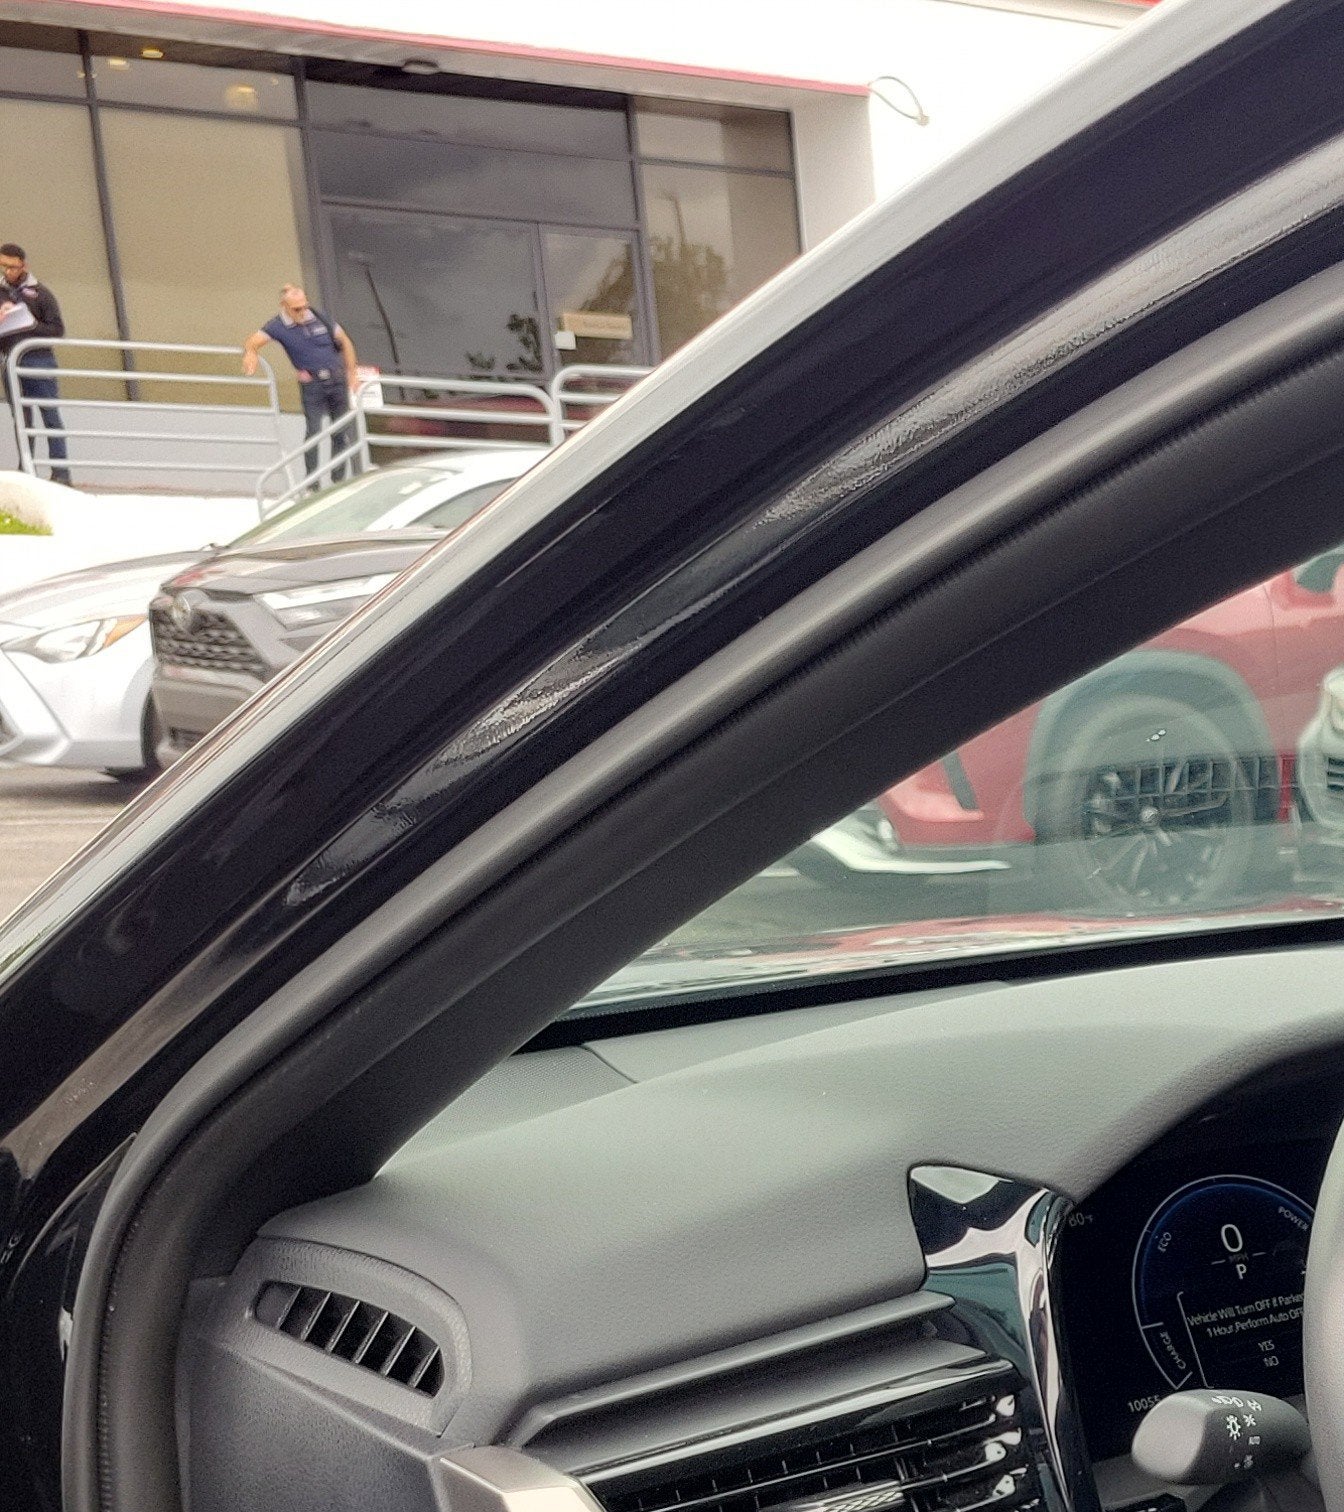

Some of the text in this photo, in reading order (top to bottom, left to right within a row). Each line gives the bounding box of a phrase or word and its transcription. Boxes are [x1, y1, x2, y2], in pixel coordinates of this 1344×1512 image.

[1157, 1232, 1172, 1252] ECO
[1220, 1223, 1243, 1252] 0
[1235, 1263, 1247, 1280] P
[1187, 1312, 1218, 1326] Vehicle
[1217, 1306, 1236, 1319] Will
[1235, 1304, 1256, 1315] Turn
[1254, 1299, 1270, 1311] OFF
[1269, 1312, 1289, 1323] Auto
[1160, 1331, 1187, 1370] CHARGE
[1258, 1340, 1275, 1352] YES
[1263, 1355, 1279, 1367] NO
